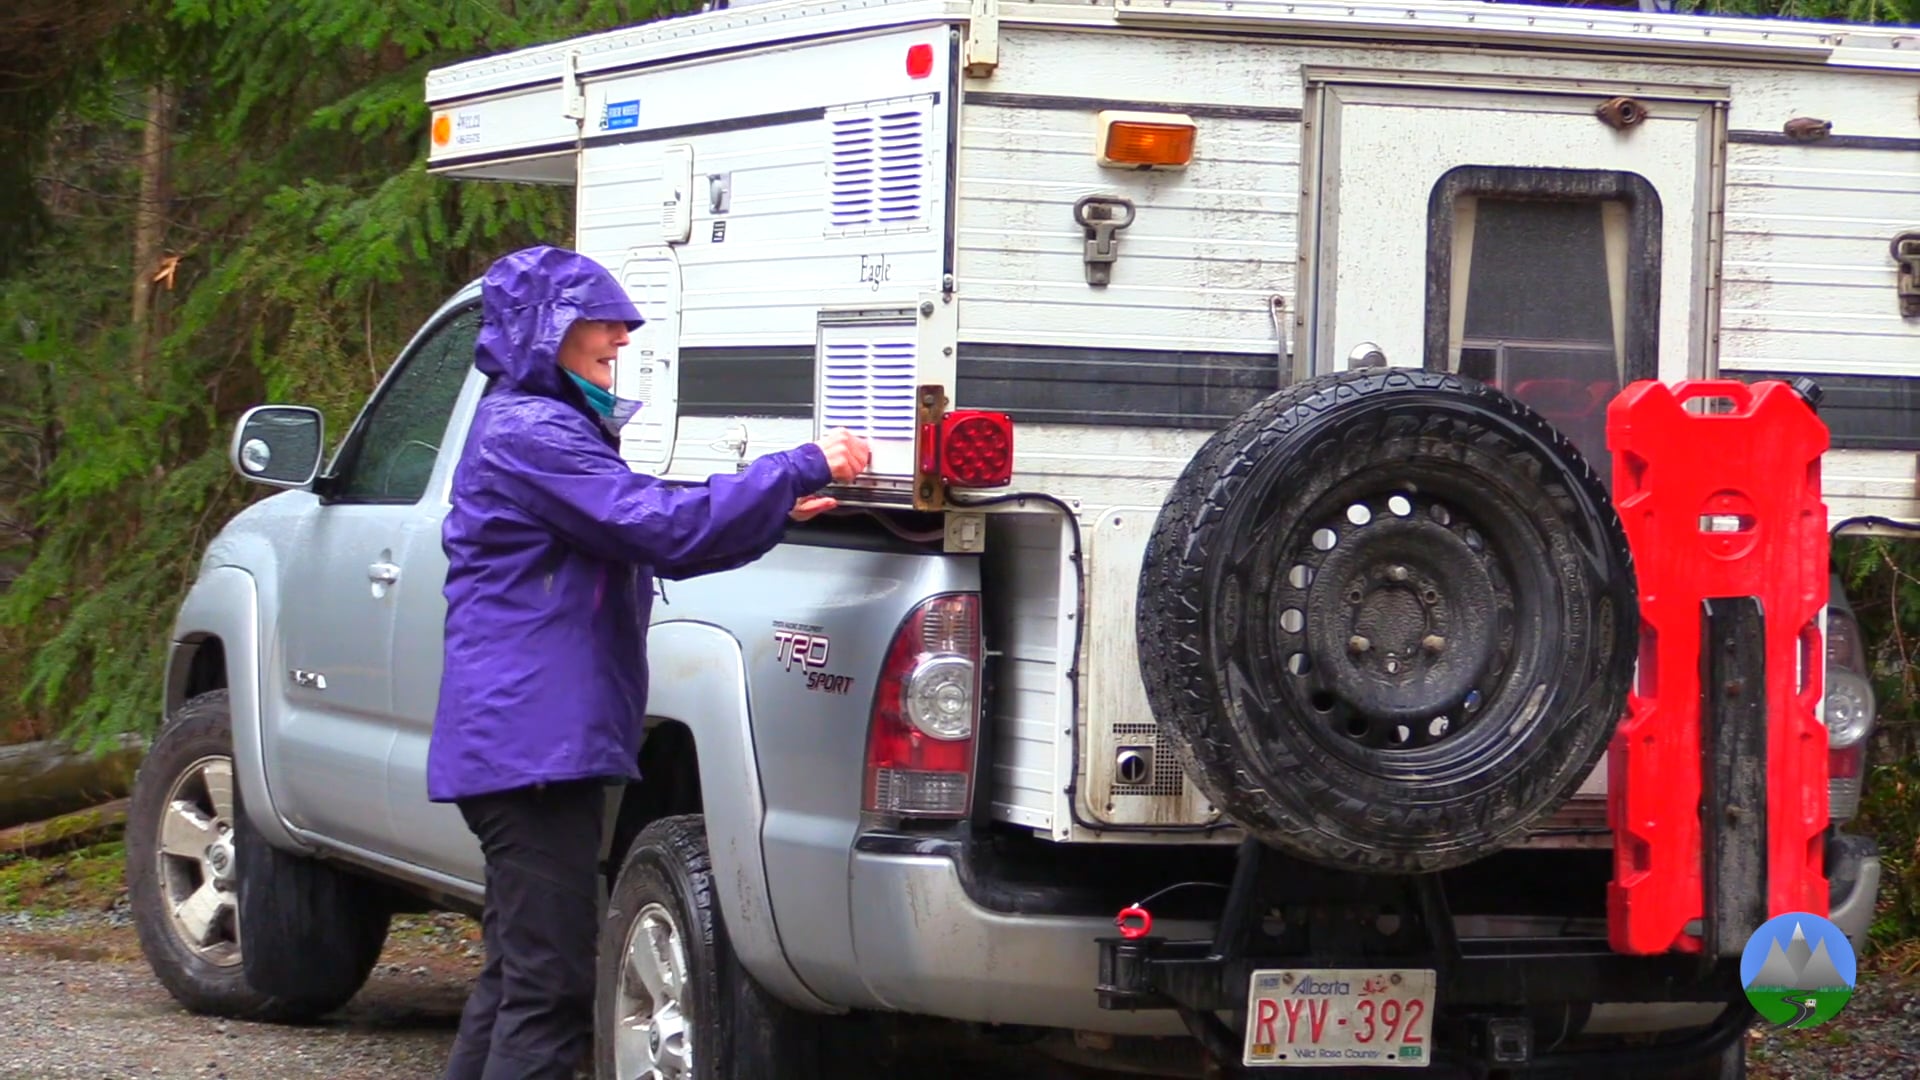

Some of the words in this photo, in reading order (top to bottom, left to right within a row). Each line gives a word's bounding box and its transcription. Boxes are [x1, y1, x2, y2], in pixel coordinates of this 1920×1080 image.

[860, 253, 891, 292] Eagle
[774, 630, 830, 675] TRD
[806, 671, 855, 695] SPORT
[1291, 976, 1350, 995] Alberta
[1255, 999, 1425, 1044] RYV-392
